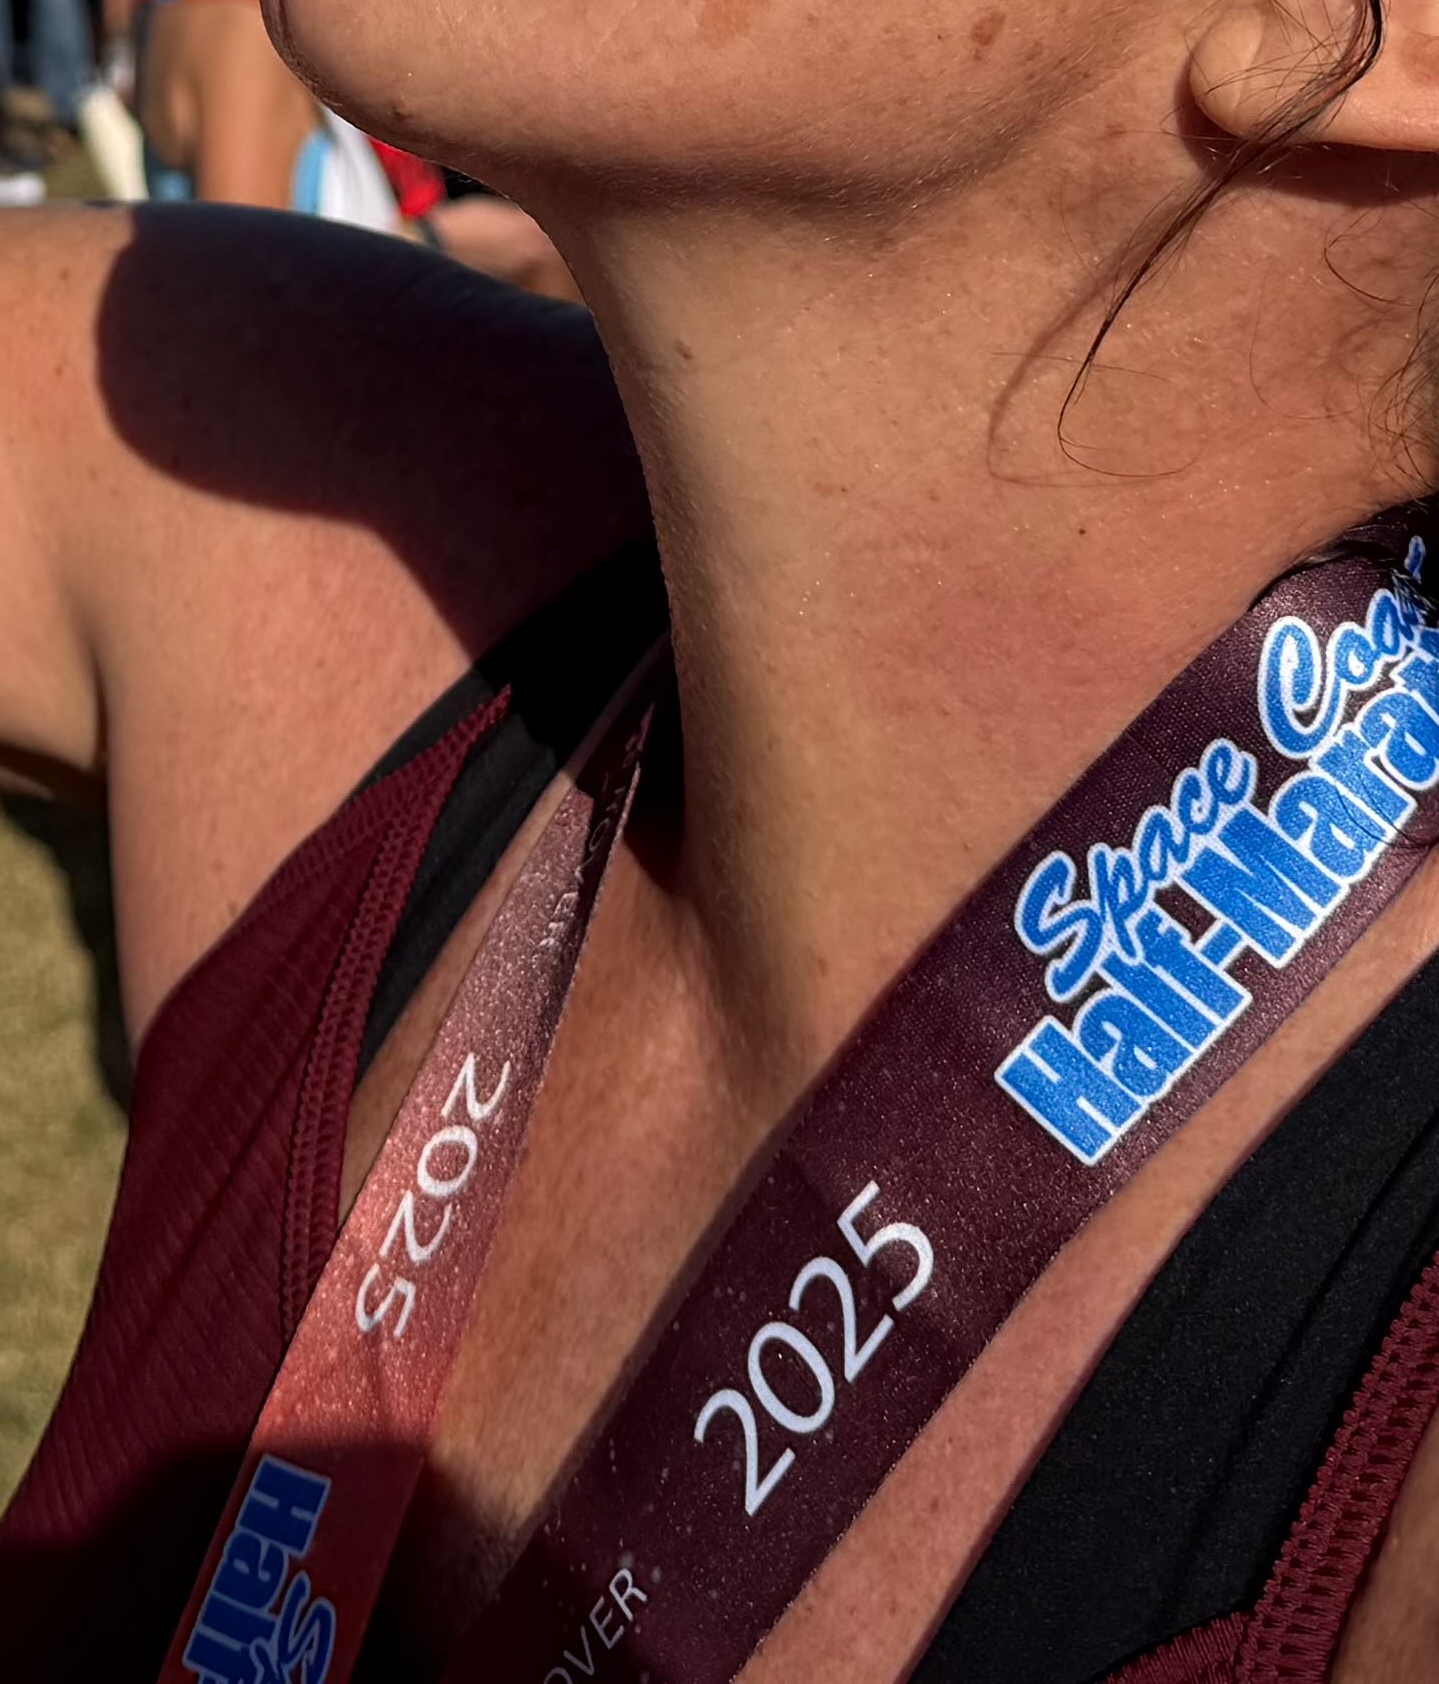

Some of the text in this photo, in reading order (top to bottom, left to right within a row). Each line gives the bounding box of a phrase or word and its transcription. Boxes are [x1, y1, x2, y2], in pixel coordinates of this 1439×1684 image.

[1013, 535, 1427, 1005] Space Coa
[354, 1051, 511, 1339] 2025
[693, 1179, 935, 1517] 2025
[181, 1452, 332, 1684] Half
